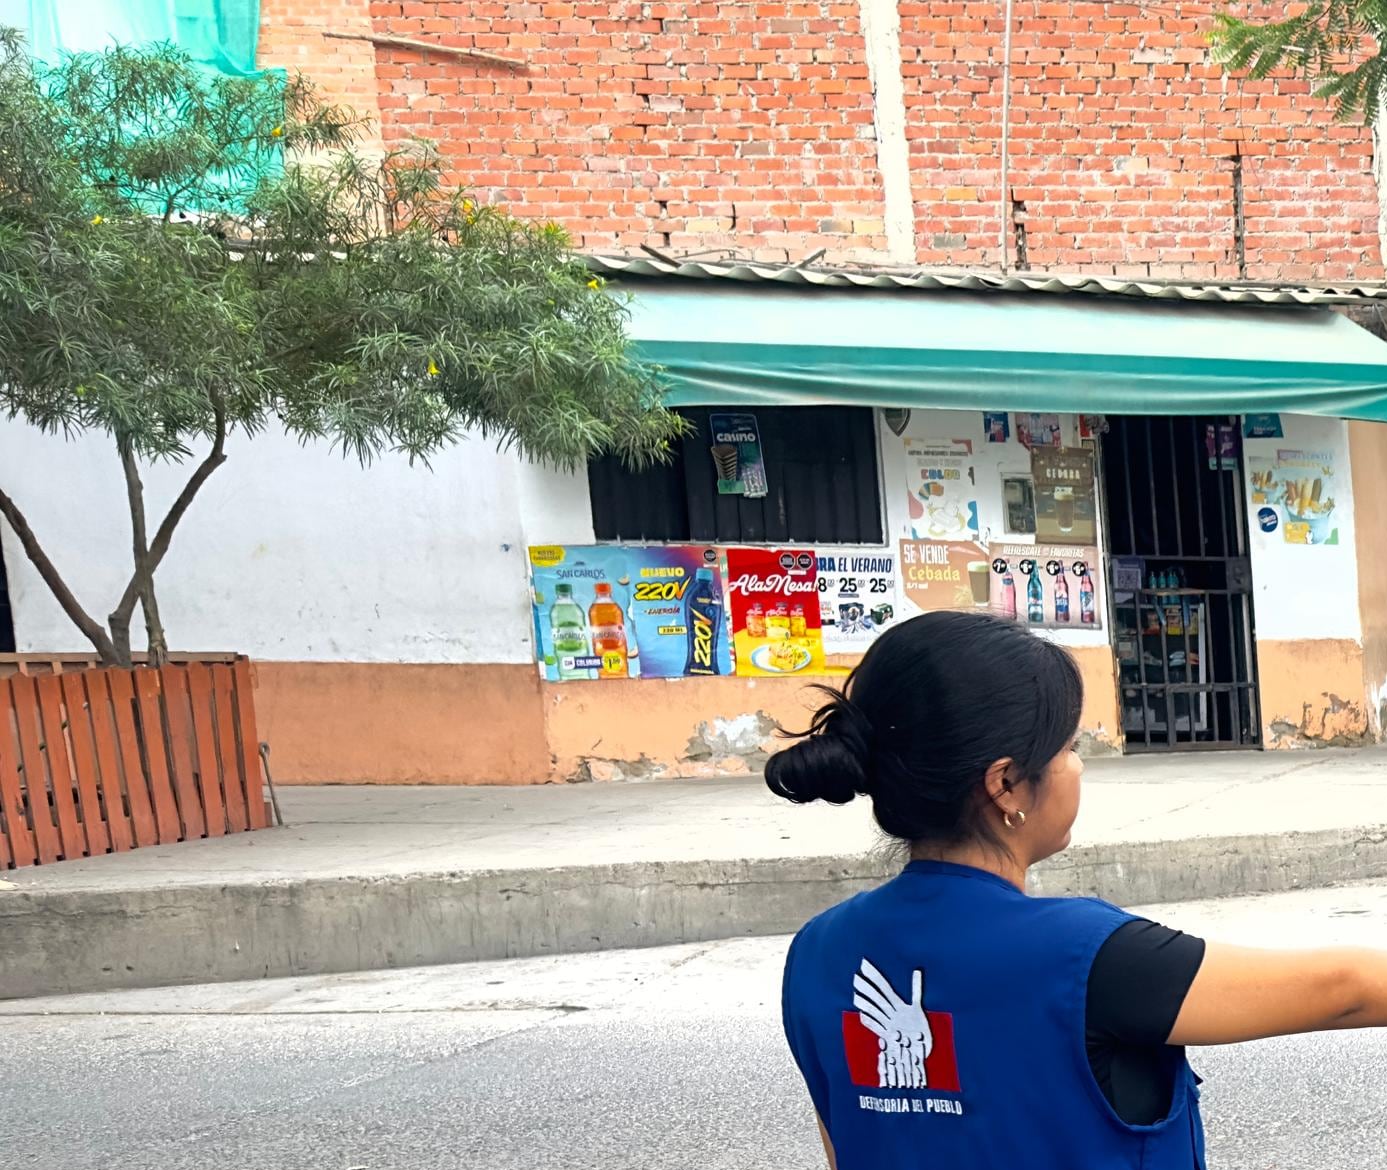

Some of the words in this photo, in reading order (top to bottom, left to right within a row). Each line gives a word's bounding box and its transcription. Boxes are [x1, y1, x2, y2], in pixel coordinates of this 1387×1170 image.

[716, 432, 756, 442] casino
[903, 544, 917, 564] SE
[919, 544, 950, 564] VENDE
[640, 566, 685, 578] NUEVO
[838, 557, 849, 572] EL
[851, 558, 893, 573] VERANO
[908, 565, 960, 581] Cebada
[634, 576, 691, 601] 220V
[839, 577, 857, 593] 25
[870, 578, 887, 593] 25
[689, 606, 713, 667] 220V
[926, 1097, 963, 1115] PUEBLO
